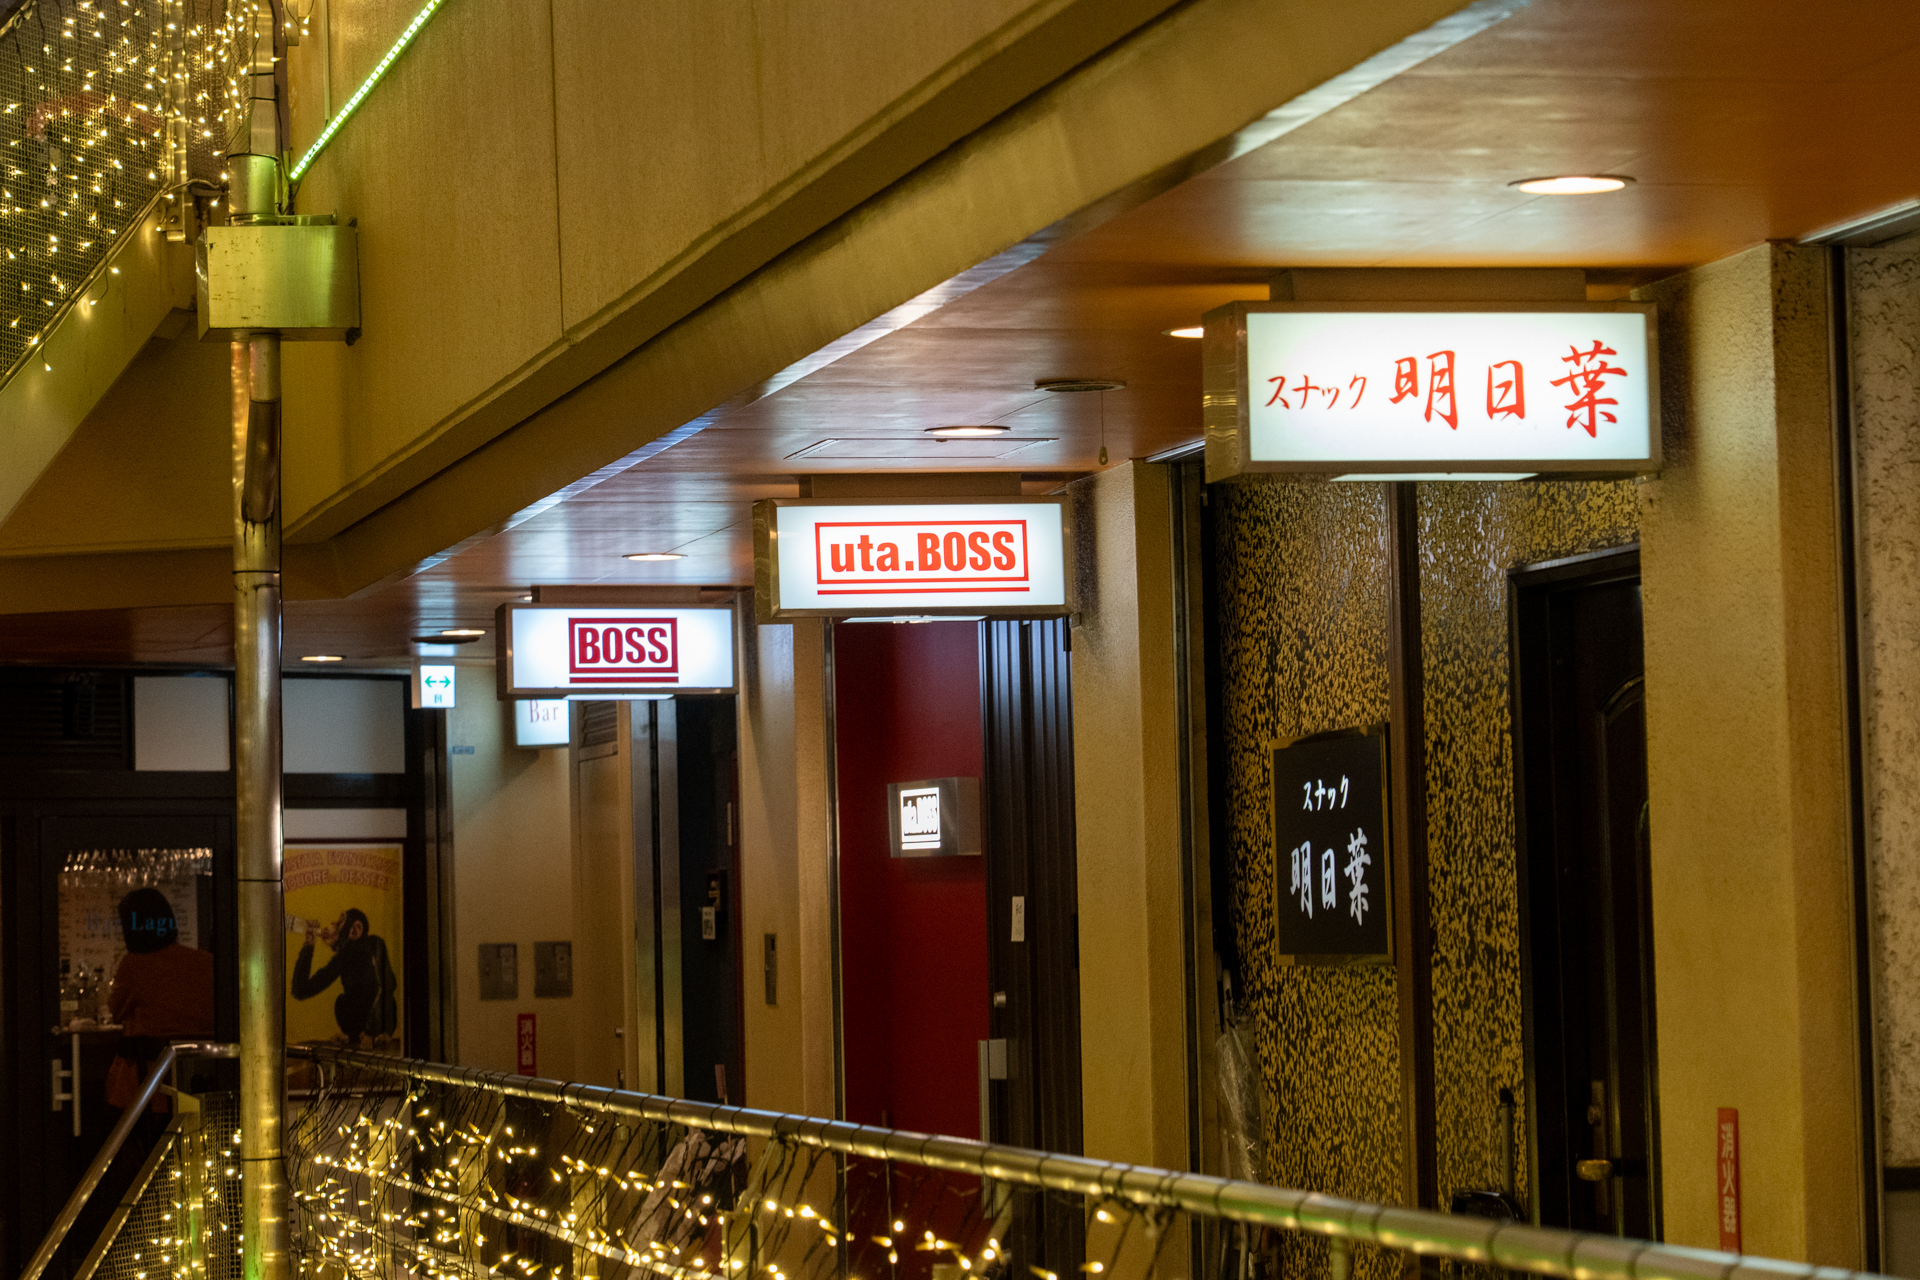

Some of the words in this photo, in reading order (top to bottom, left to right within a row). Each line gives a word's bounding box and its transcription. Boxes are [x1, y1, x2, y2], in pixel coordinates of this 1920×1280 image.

[1265, 374, 1366, 410] スナック
[1389, 340, 1628, 438] 明日葉
[830, 531, 1016, 573] uta.BOSS
[577, 626, 669, 665] BOSS
[529, 699, 559, 723] Bar
[1303, 774, 1349, 812] スナック
[1290, 827, 1372, 926] 明日葉
[1720, 1122, 1737, 1233] 消火器
